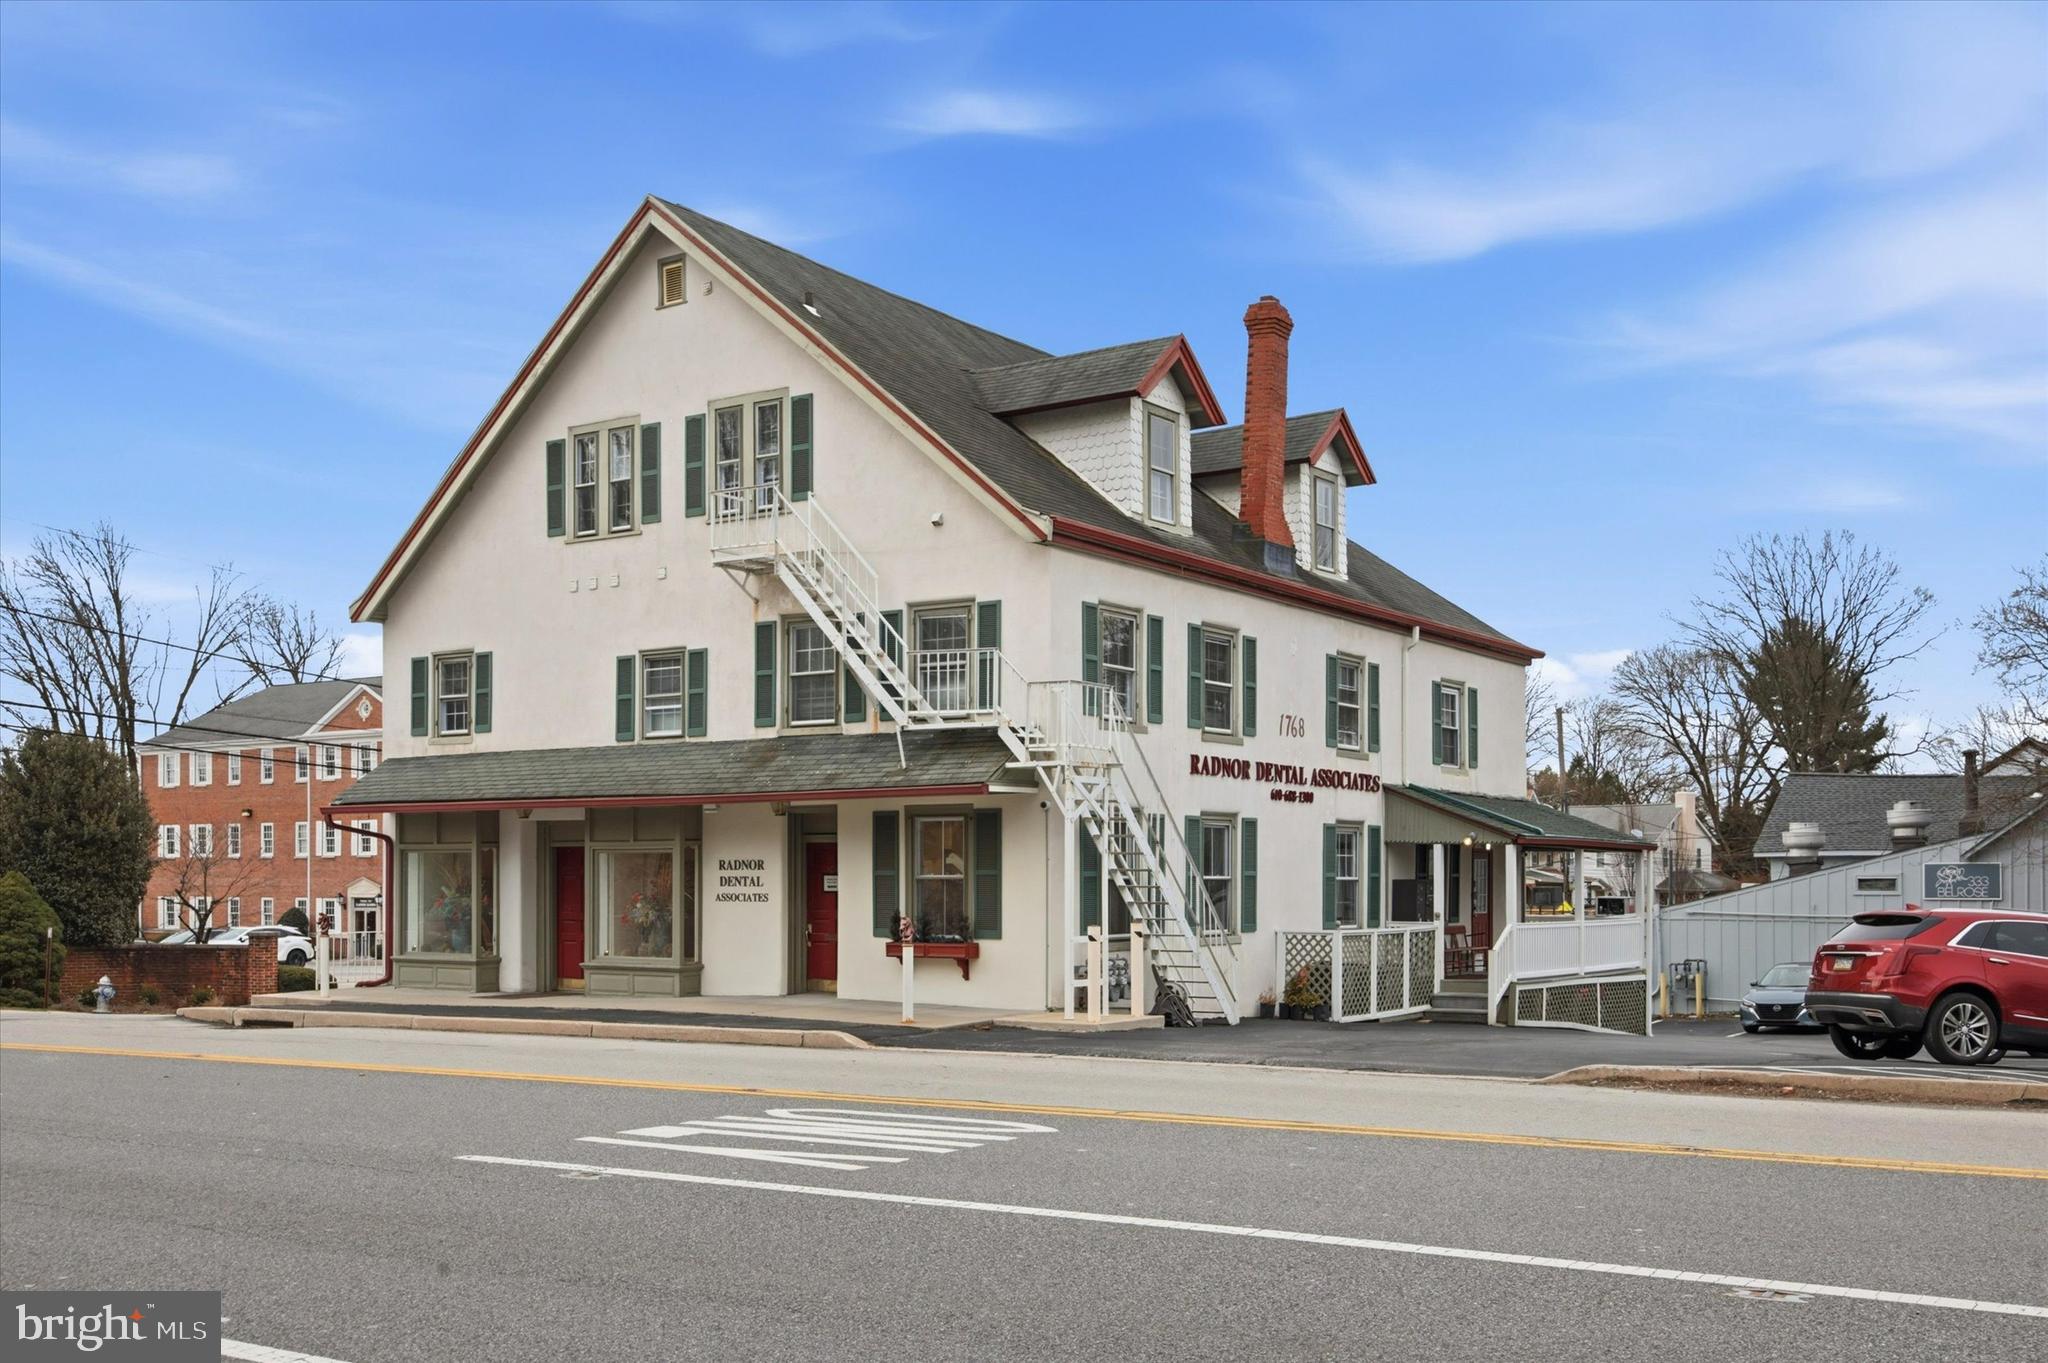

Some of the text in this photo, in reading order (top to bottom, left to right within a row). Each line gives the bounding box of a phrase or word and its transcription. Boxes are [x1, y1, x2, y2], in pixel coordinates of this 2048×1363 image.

[1279, 713, 1305, 738] 1768
[1190, 754, 1381, 793] RADNOR DENTAL ASSOCIATES
[718, 859, 765, 871] RADNOR
[719, 876, 764, 887] DENTAL
[715, 892, 769, 903] ASSOCIATES
[1937, 886, 1990, 898] BELROSE
